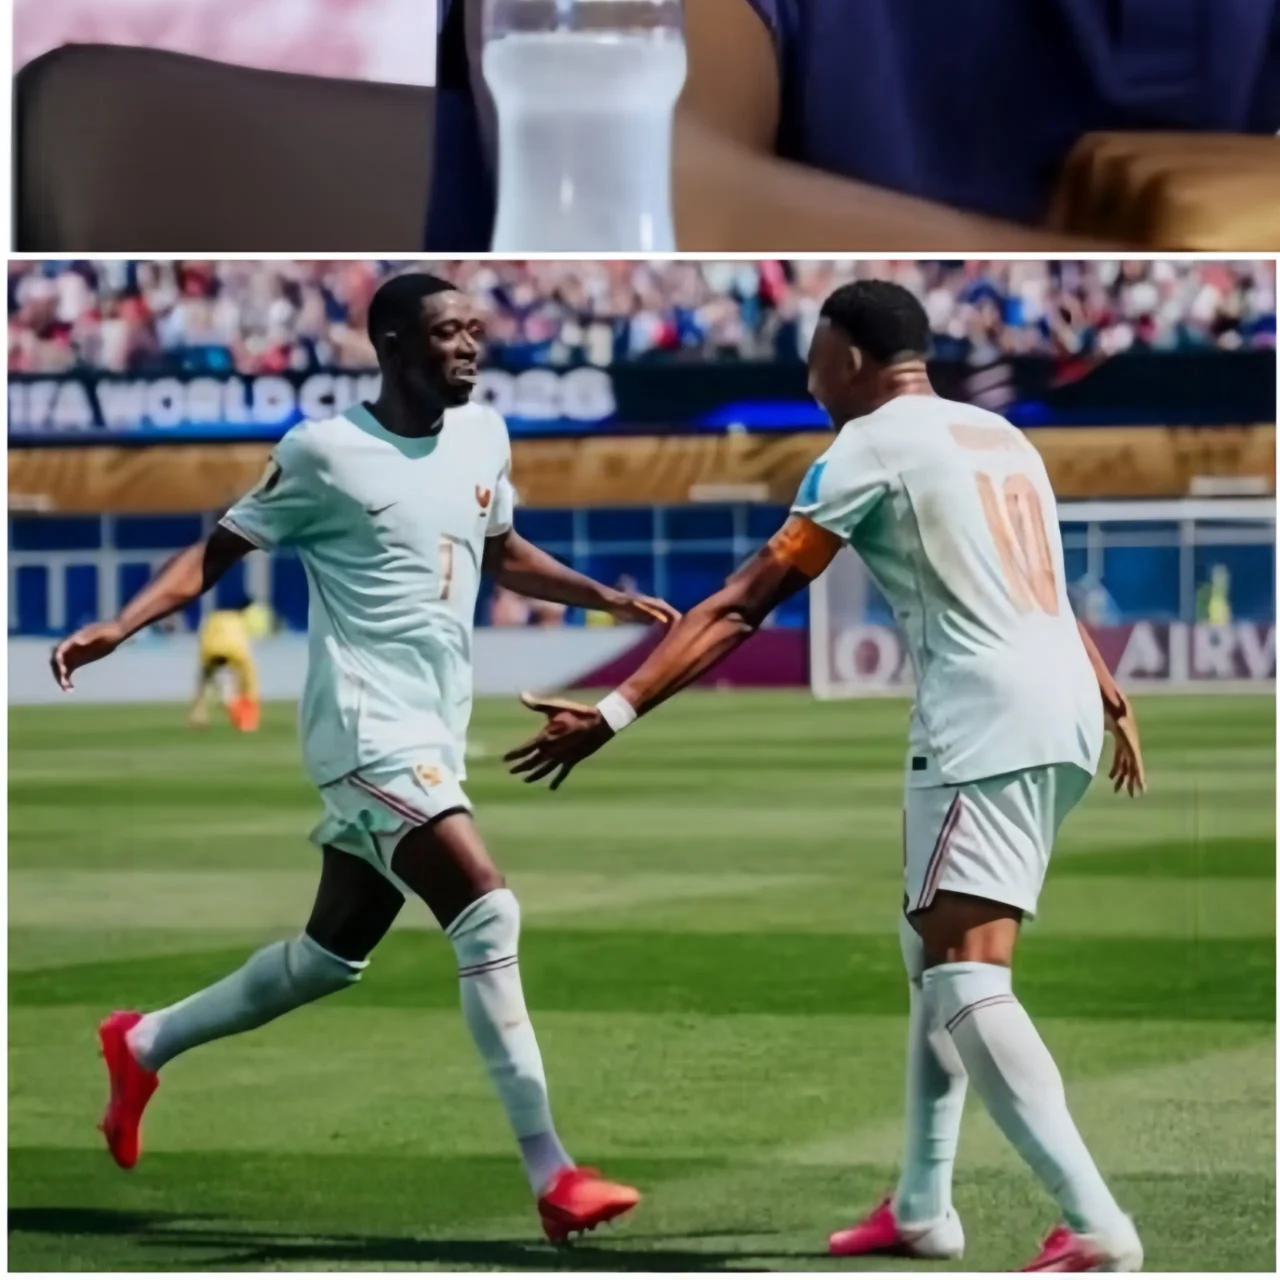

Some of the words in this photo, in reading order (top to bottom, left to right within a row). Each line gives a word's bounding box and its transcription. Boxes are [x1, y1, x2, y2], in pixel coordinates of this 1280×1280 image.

[8, 378, 94, 429] IFA
[97, 375, 296, 428] WORLD
[300, 372, 382, 421] CU
[974, 468, 1060, 617] 10
